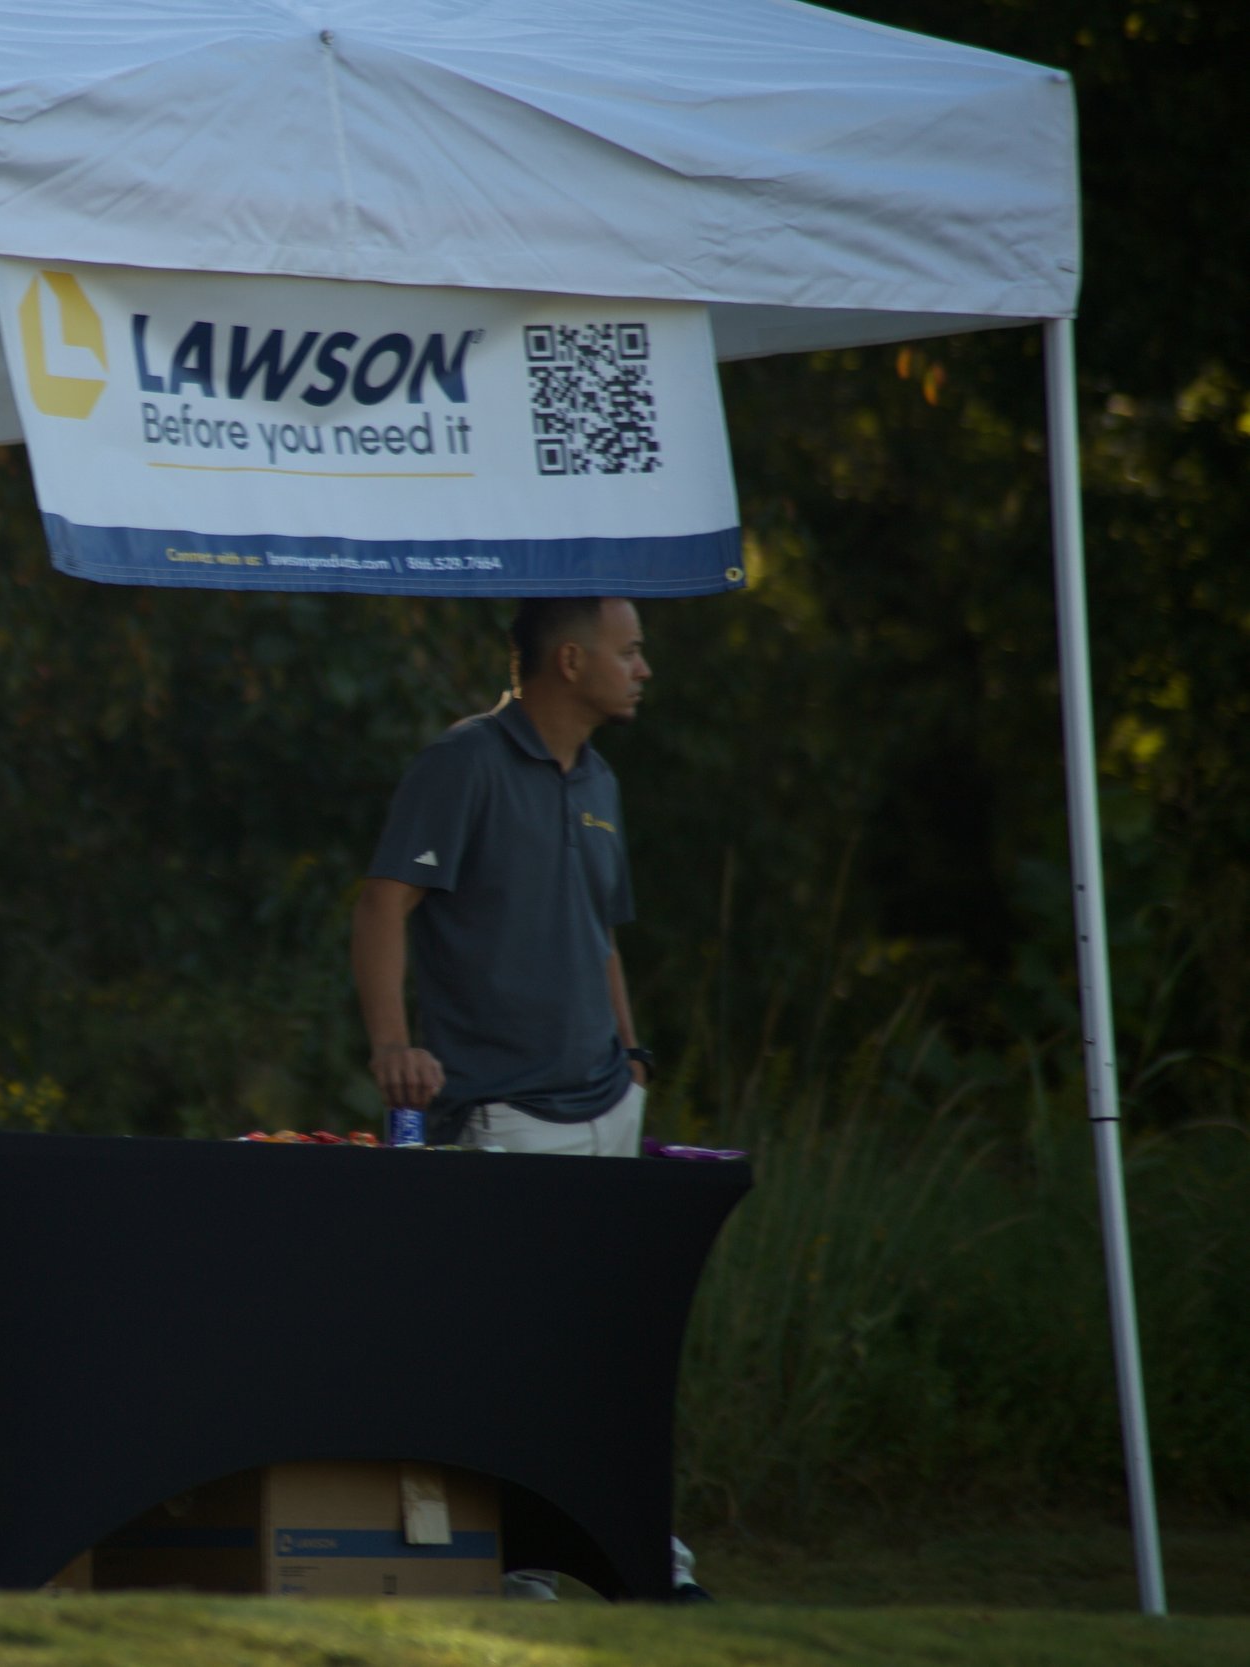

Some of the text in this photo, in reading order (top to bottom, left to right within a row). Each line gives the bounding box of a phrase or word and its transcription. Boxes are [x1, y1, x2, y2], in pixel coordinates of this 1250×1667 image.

[131, 313, 474, 406] LAWSON
[142, 402, 472, 464] Before you need it
